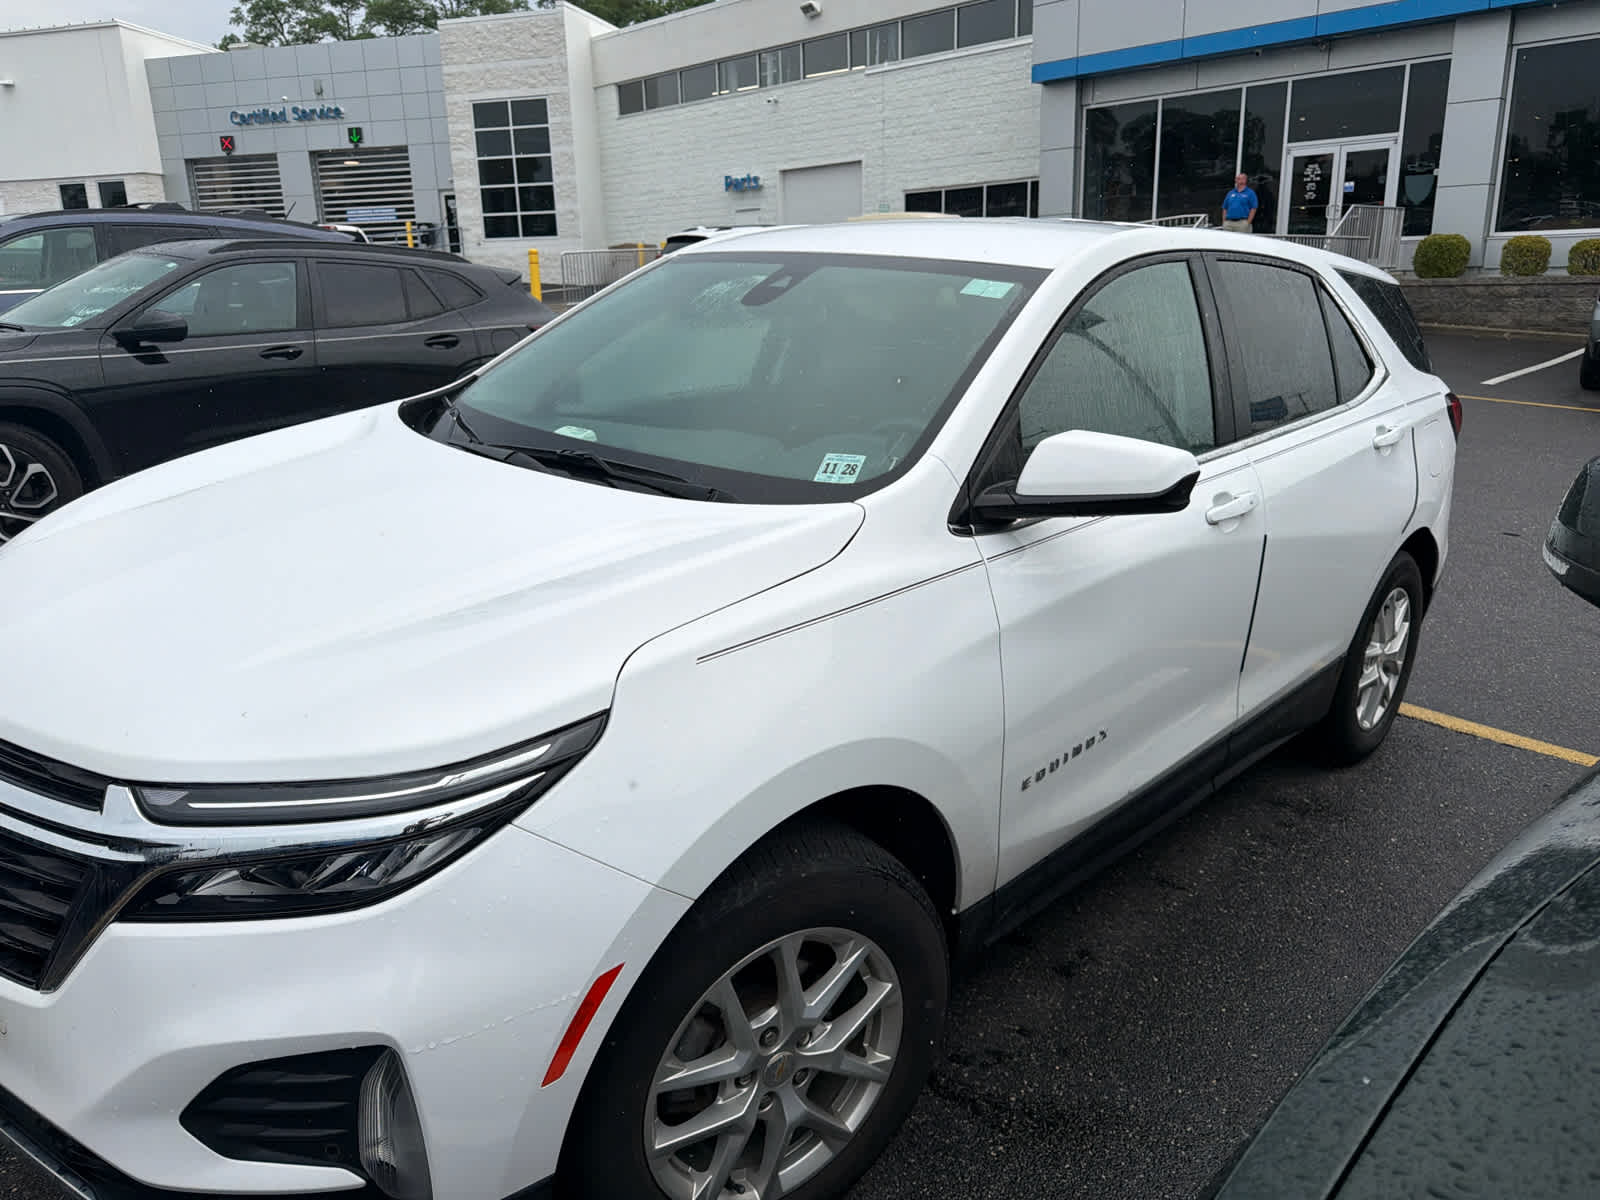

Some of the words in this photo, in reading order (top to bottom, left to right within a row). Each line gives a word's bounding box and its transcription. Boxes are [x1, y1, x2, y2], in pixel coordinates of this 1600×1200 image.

[230, 106, 287, 125] Certified
[291, 105, 344, 121] Service
[724, 173, 761, 192] Parts
[821, 462, 839, 474] 11
[841, 463, 858, 475] 28
[1021, 731, 1107, 792] EQUINOX
